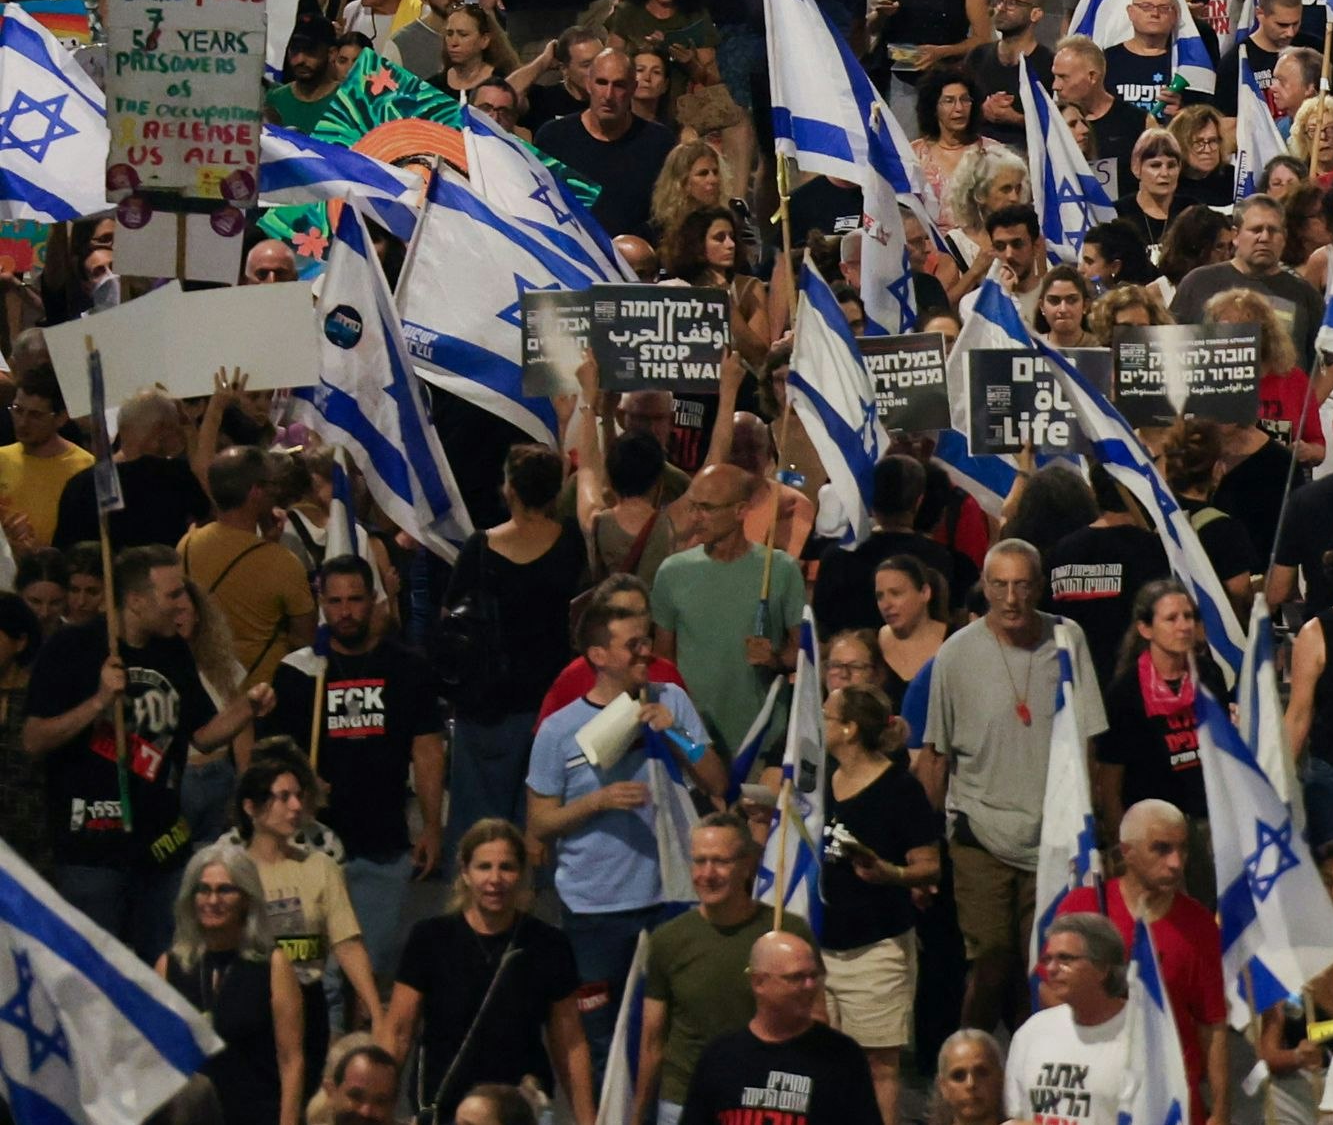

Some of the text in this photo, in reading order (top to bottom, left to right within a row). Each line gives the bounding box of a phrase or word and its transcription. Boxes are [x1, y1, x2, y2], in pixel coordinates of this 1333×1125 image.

[177, 30, 250, 54] YEARS
[115, 51, 237, 77] PRISONERS
[115, 97, 151, 117] THE
[142, 119, 254, 146] RELEASE
[127, 145, 164, 167] US
[621, 296, 724, 318] די למלחמה
[639, 344, 691, 362] STOP
[1214, 346, 1256, 363] חובה
[639, 361, 679, 379] THE
[1215, 365, 1256, 380] בטרור
[1002, 412, 1071, 447] Life
[327, 686, 386, 713] FCK
[327, 713, 385, 730] BNGVR
[1036, 1062, 1090, 1090] אתה
